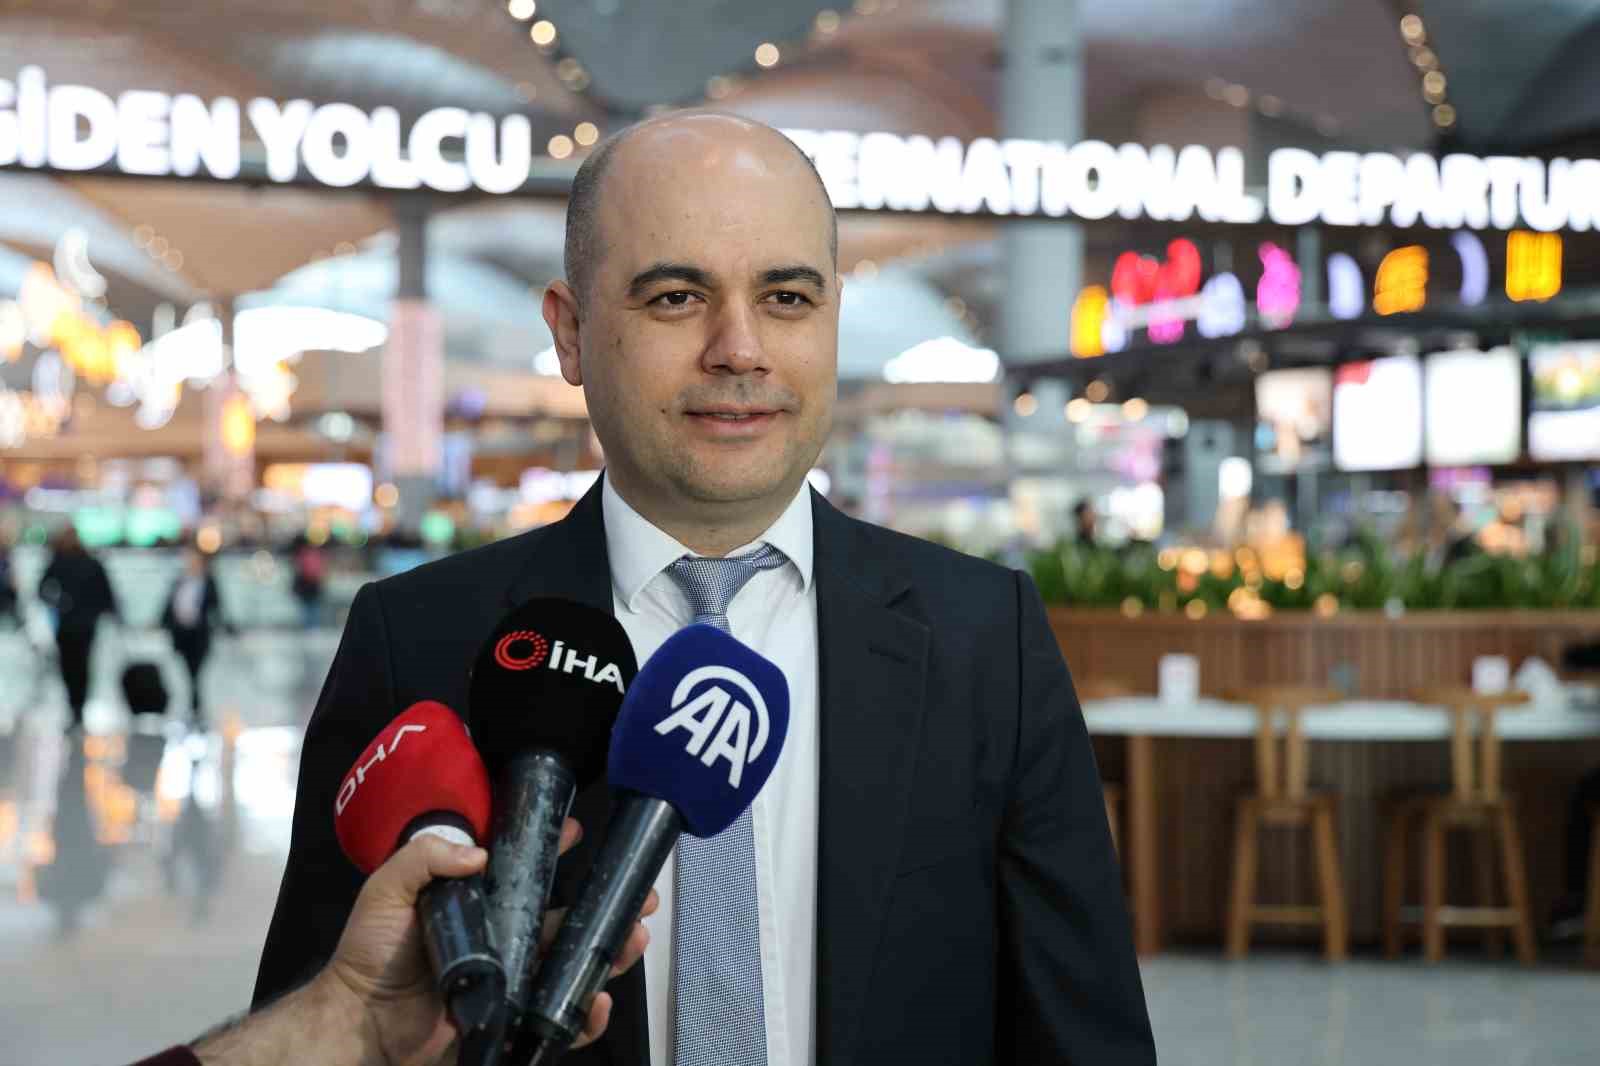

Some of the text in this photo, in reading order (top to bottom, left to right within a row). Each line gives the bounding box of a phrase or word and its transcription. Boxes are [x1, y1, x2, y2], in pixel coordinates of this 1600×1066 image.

[248, 98, 531, 193] YOLCU
[549, 640, 625, 694] İHA
[654, 686, 752, 789] AA
